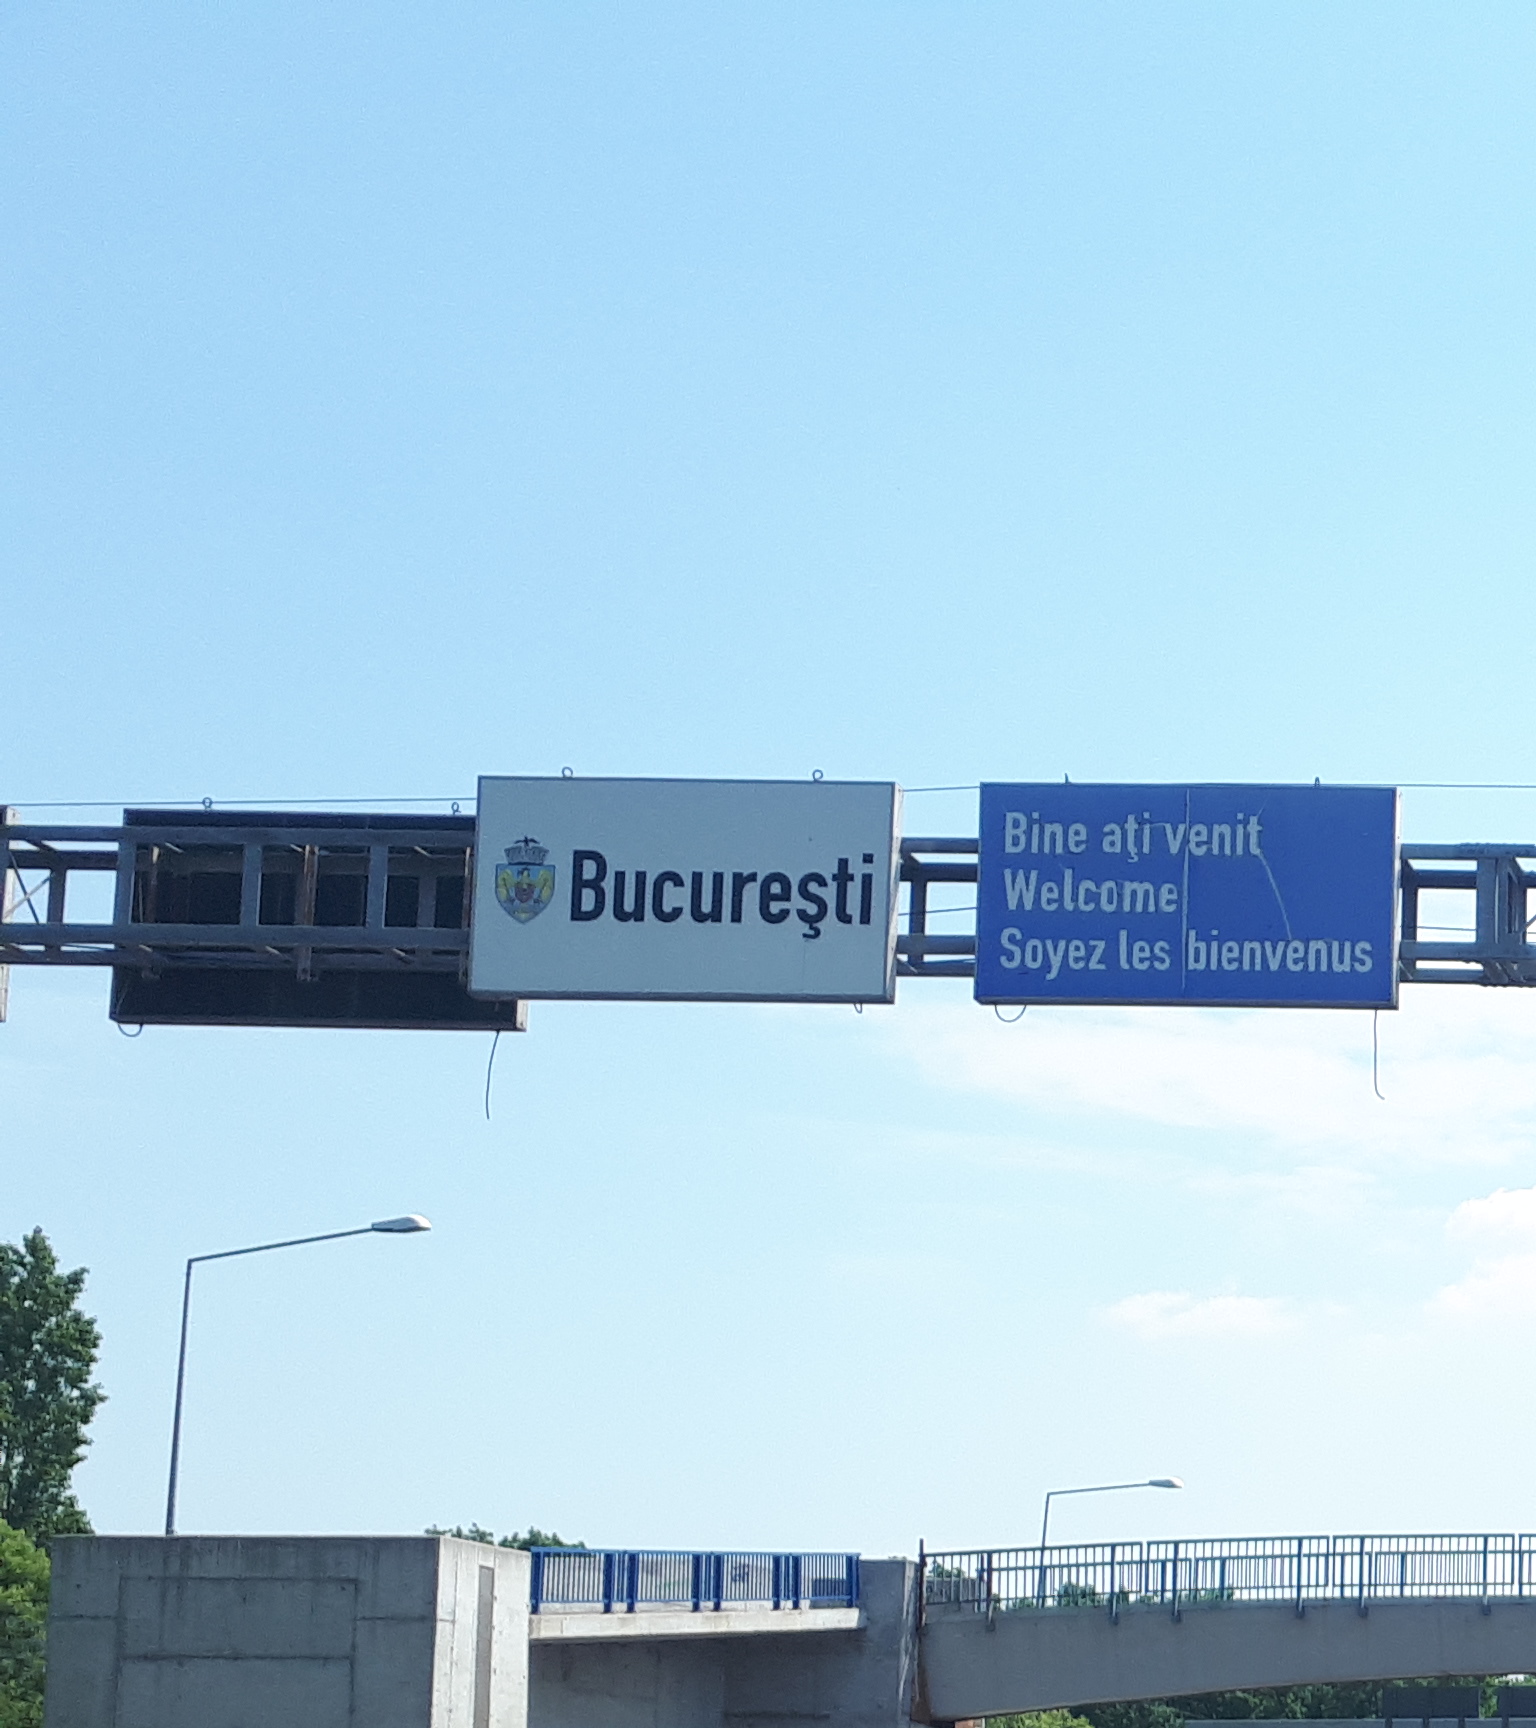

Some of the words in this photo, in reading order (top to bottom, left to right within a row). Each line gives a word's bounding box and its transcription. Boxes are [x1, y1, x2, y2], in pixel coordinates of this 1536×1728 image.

[1004, 811, 1087, 855] Bine
[1164, 813, 1263, 857] venit
[1003, 867, 1178, 914] Welcome
[1000, 926, 1106, 981] Soyez
[1119, 929, 1172, 972] les
[1187, 928, 1374, 973] bienvenus
